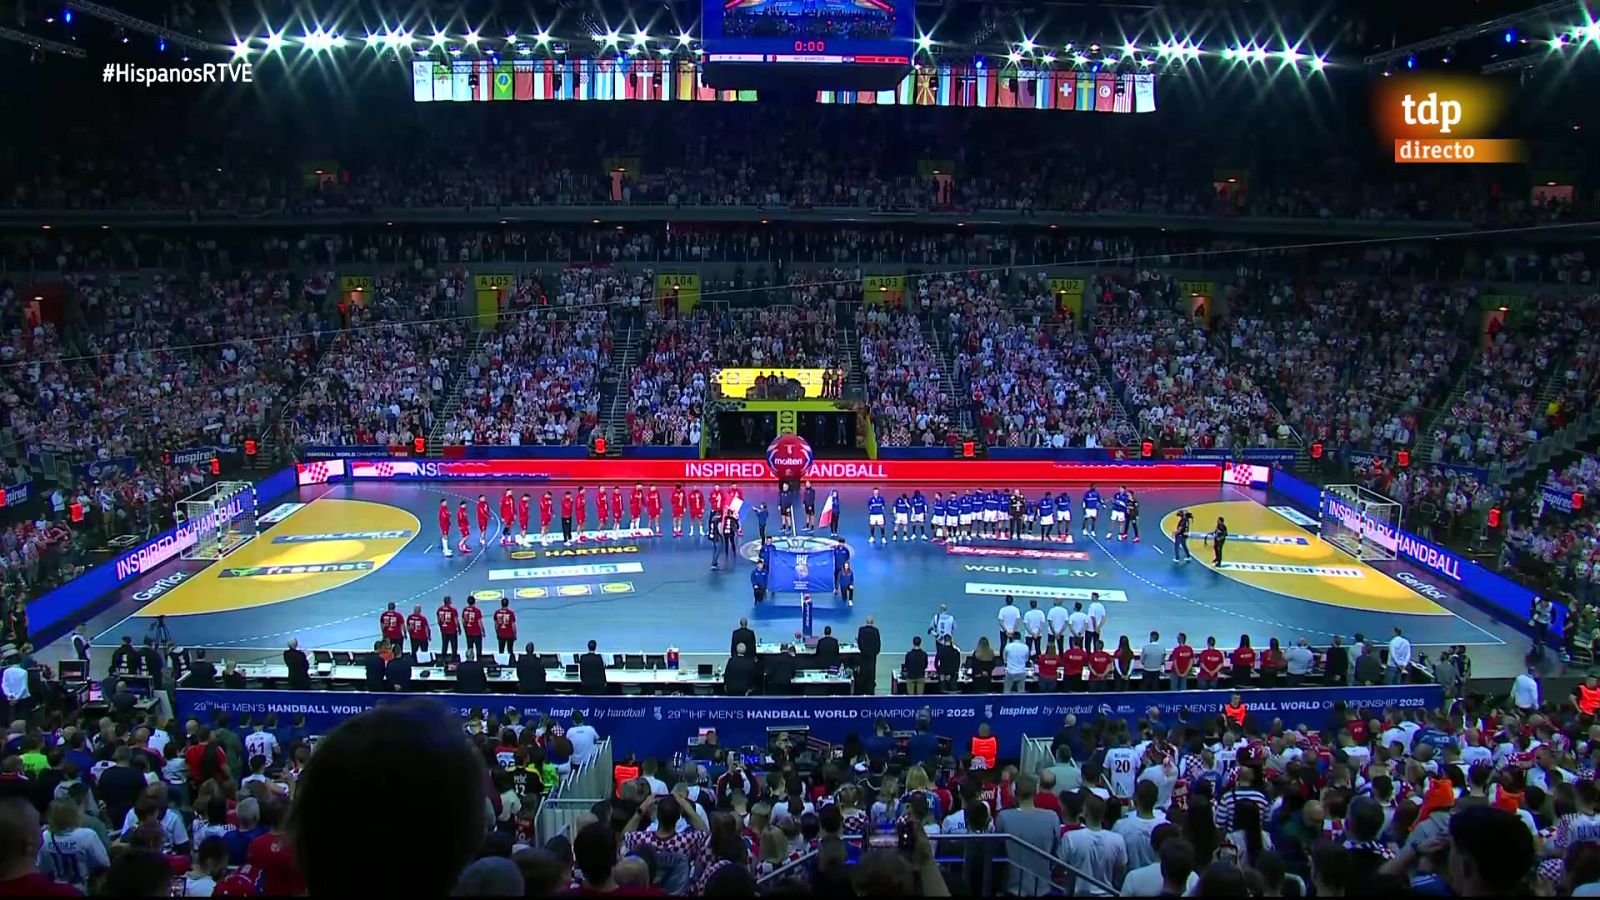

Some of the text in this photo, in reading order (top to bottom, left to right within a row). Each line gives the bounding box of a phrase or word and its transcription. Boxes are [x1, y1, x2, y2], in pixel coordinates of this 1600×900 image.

[794, 41, 825, 52] 0:00
[490, 276, 509, 286] 105
[674, 276, 692, 286] 104
[879, 278, 898, 286] 103
[1060, 280, 1078, 289] 102
[774, 458, 802, 466] molten
[686, 463, 765, 478] INSPIRED
[545, 546, 638, 557] HARTING
[1394, 531, 1462, 581] HANDBALL
[266, 561, 368, 575] freenet
[964, 564, 1038, 574] waipu
[1235, 564, 1359, 576] INTERSPORT
[132, 572, 188, 600] Gerflor
[1396, 572, 1447, 600] Gerflor
[232, 703, 266, 712] MEN'S
[268, 704, 329, 714] HANDBALL
[1281, 700, 1320, 710] WORLD
[1400, 698, 1424, 707] 2025
[594, 708, 605, 719] by
[607, 707, 646, 718] handball
[689, 710, 706, 719] IHF
[708, 710, 744, 720] MEN'S
[746, 710, 810, 719] HANDBALL
[814, 710, 858, 718] WORLD
[946, 708, 976, 717] 2025
[1000, 705, 1093, 717] inspired by handball
[250, 742, 264, 754] 41
[1115, 760, 1130, 773] 20
